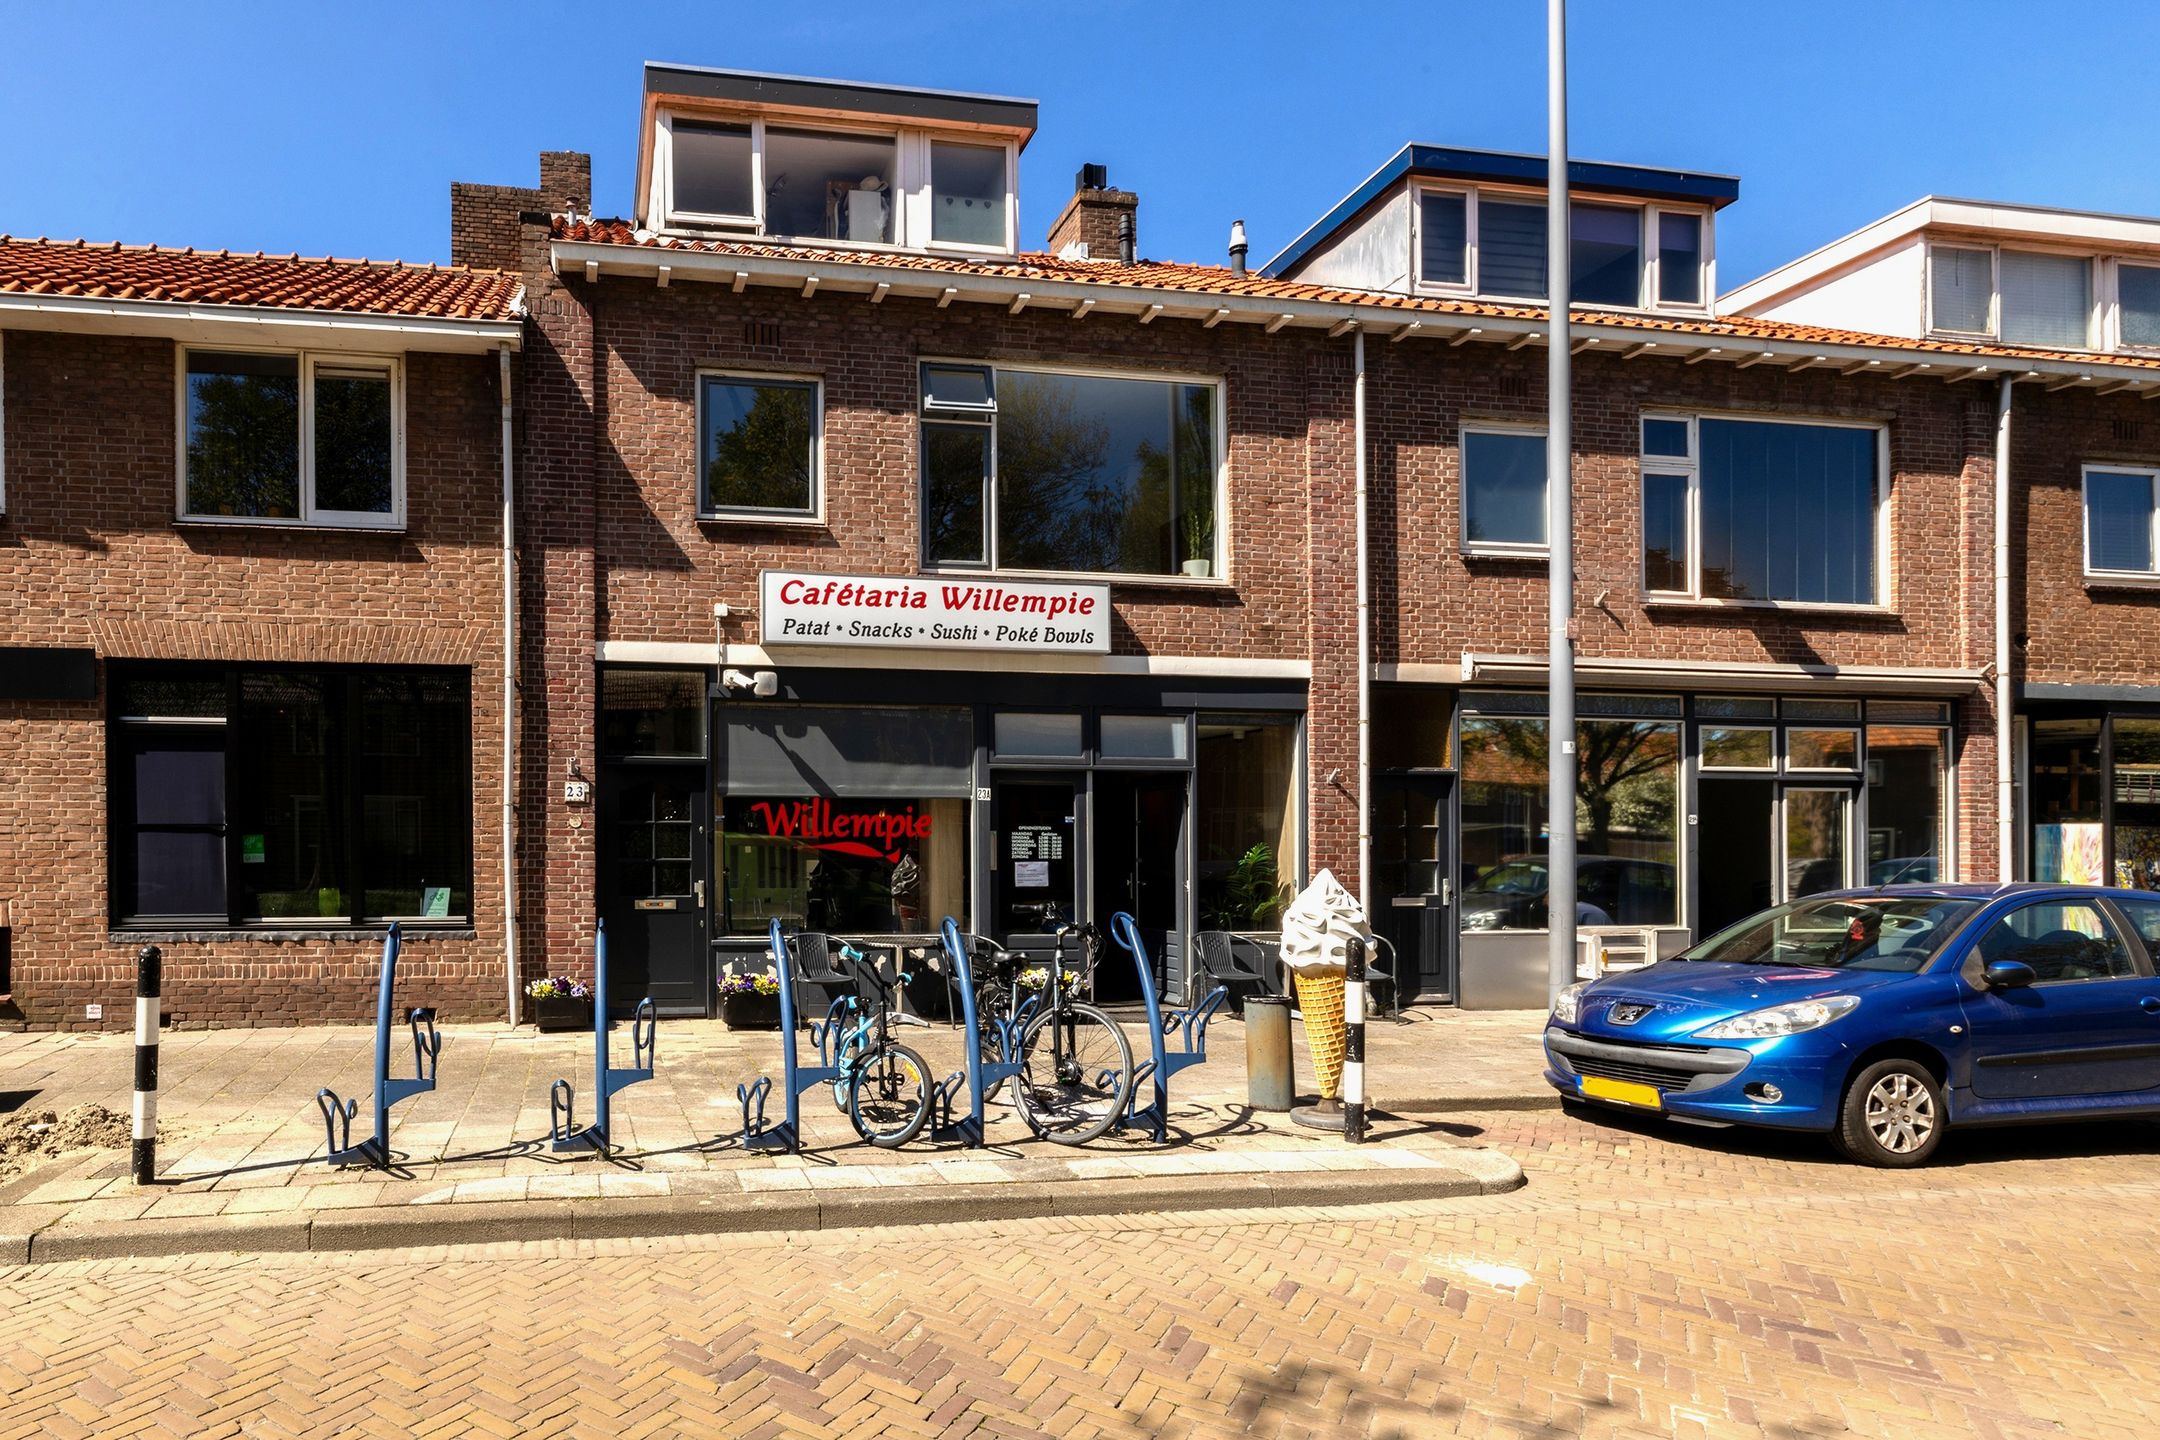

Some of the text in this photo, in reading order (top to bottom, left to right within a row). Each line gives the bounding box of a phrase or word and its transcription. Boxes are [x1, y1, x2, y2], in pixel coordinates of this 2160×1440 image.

[780, 579, 1095, 620] Cafétaria Willempie
[782, 618, 1095, 645] Patat Snacks Sushi Poké Bowls
[566, 786, 583, 797] 23
[978, 789, 991, 800] 23A
[751, 796, 933, 850] Willempie
